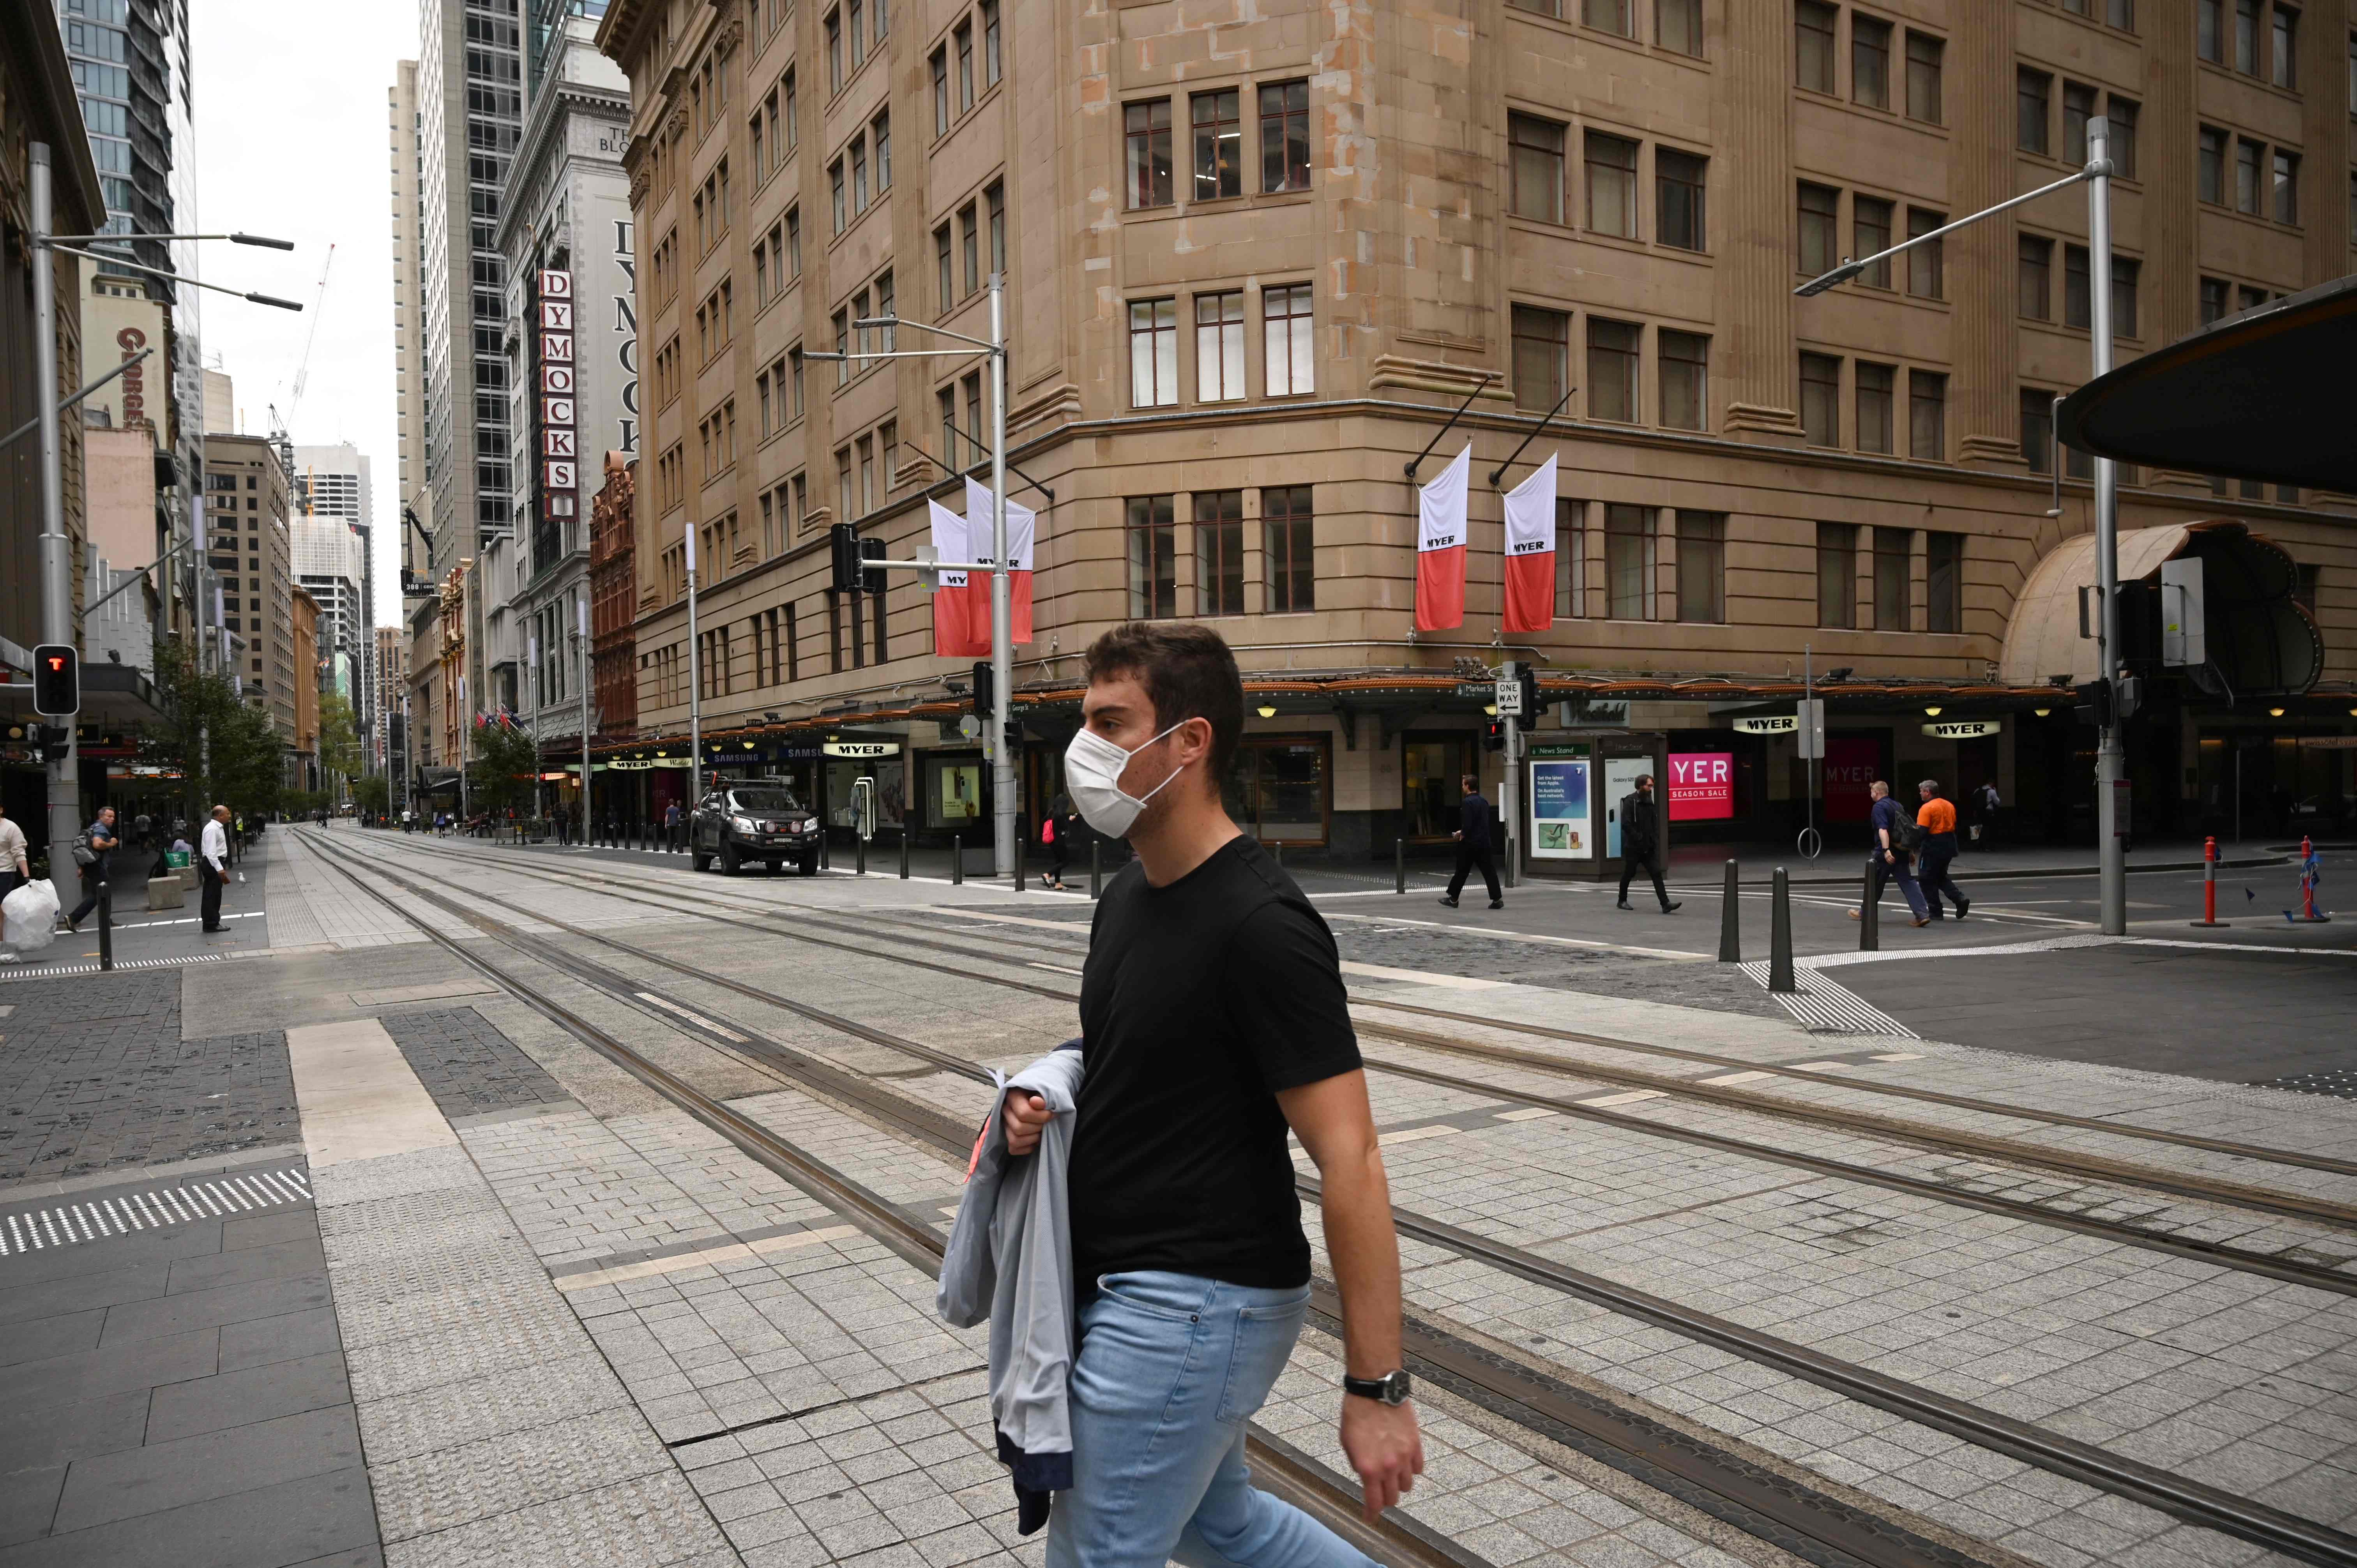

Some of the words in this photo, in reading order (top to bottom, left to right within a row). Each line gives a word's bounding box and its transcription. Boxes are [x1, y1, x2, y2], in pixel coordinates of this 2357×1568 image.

[610, 127, 629, 141] TH
[601, 138, 630, 153] BLO
[547, 274, 572, 484] DYMOCKS
[1427, 535, 1454, 548] MYER
[1513, 541, 1544, 552] MYER
[1747, 719, 1793, 730] MYER
[1935, 724, 1985, 735] MYER
[788, 748, 826, 758] SAMSU
[839, 746, 884, 754] MYER
[714, 754, 758, 763] SAMSUNG
[1674, 760, 1727, 783] YER
[1827, 766, 1874, 783] MYER
